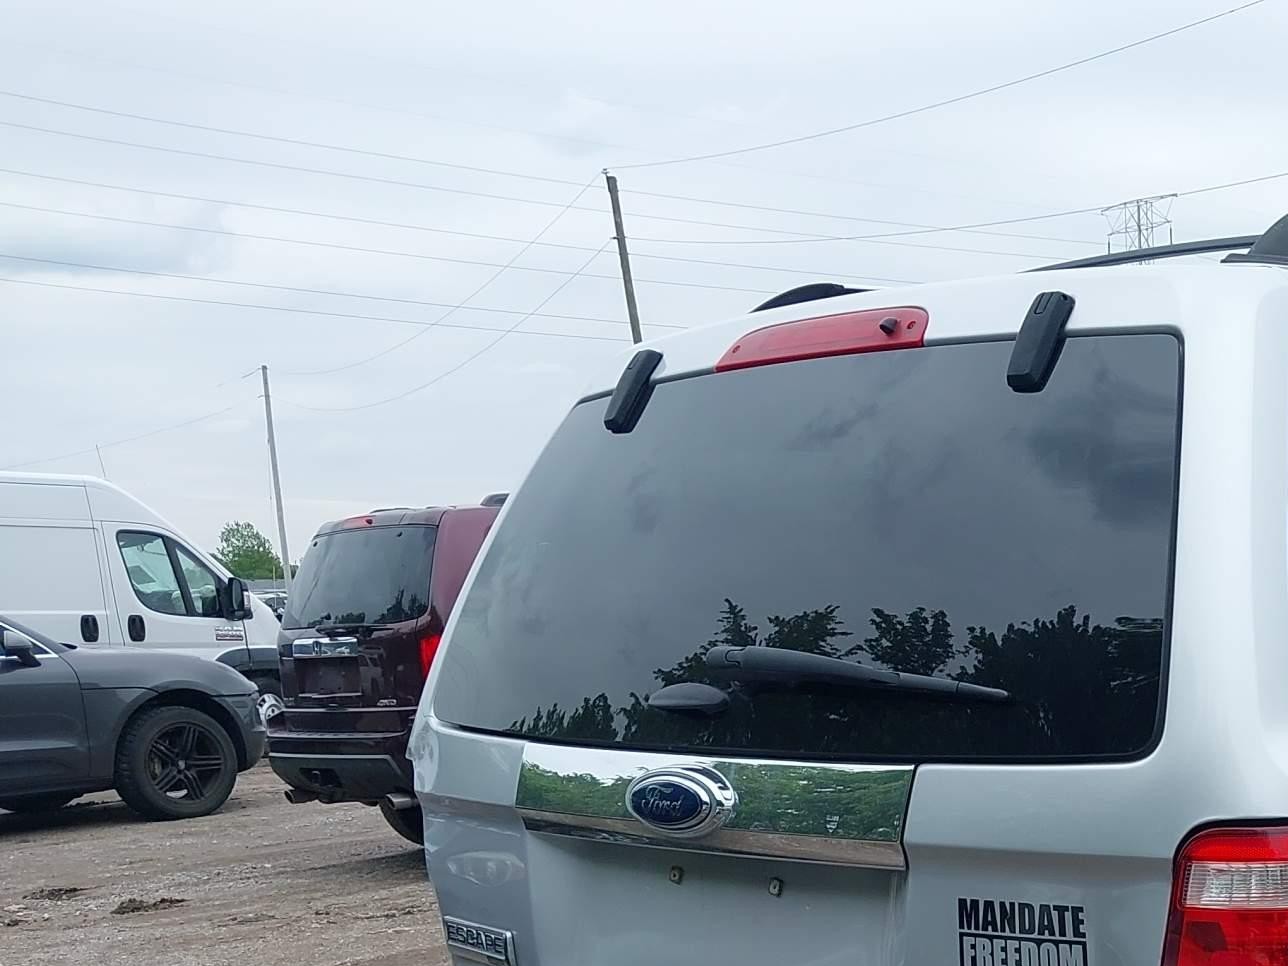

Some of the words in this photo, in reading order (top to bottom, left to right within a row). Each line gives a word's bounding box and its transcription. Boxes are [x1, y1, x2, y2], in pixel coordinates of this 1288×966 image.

[641, 784, 684, 816] Ford
[957, 897, 1087, 939] MANDATE
[446, 922, 505, 954] ESCAPE
